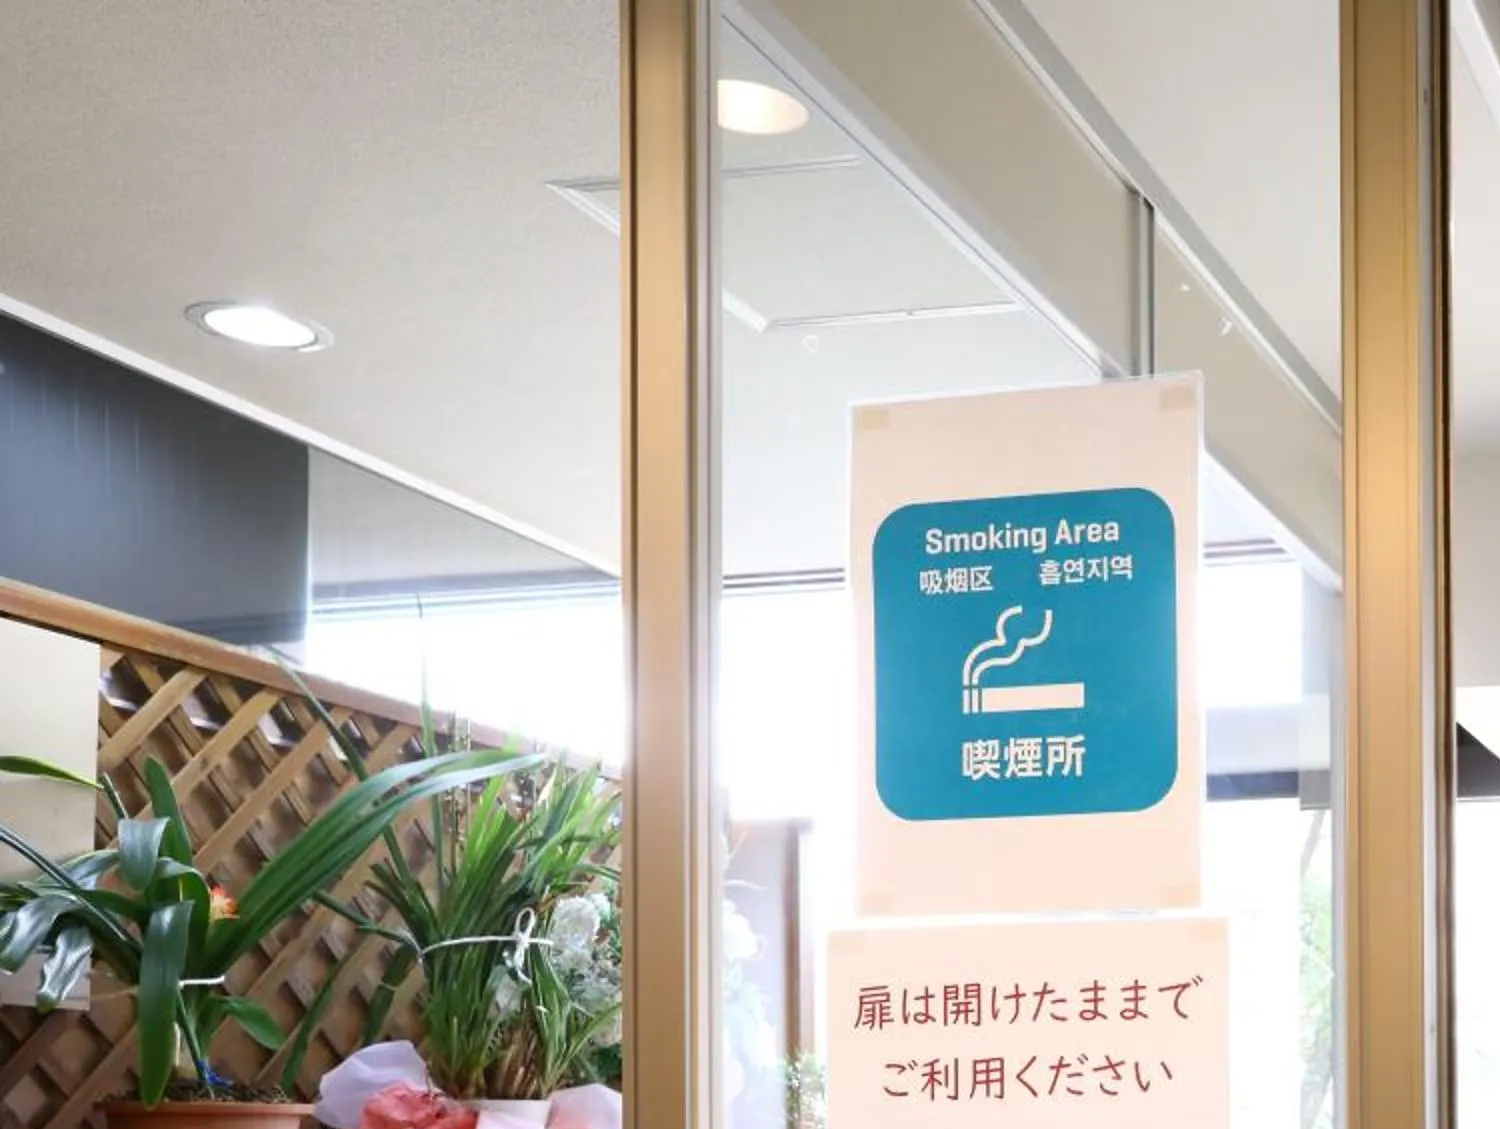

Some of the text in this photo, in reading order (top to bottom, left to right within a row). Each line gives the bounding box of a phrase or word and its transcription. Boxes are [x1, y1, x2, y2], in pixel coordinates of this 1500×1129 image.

[925, 519, 1120, 554] Smoking Area
[919, 565, 993, 595] 吸烟区
[1038, 554, 1134, 586] 흡연지역
[961, 734, 1086, 779] 喫煙所
[853, 976, 1204, 1031] 扉は開けたままで
[883, 1053, 1173, 1102] ご利用ください
